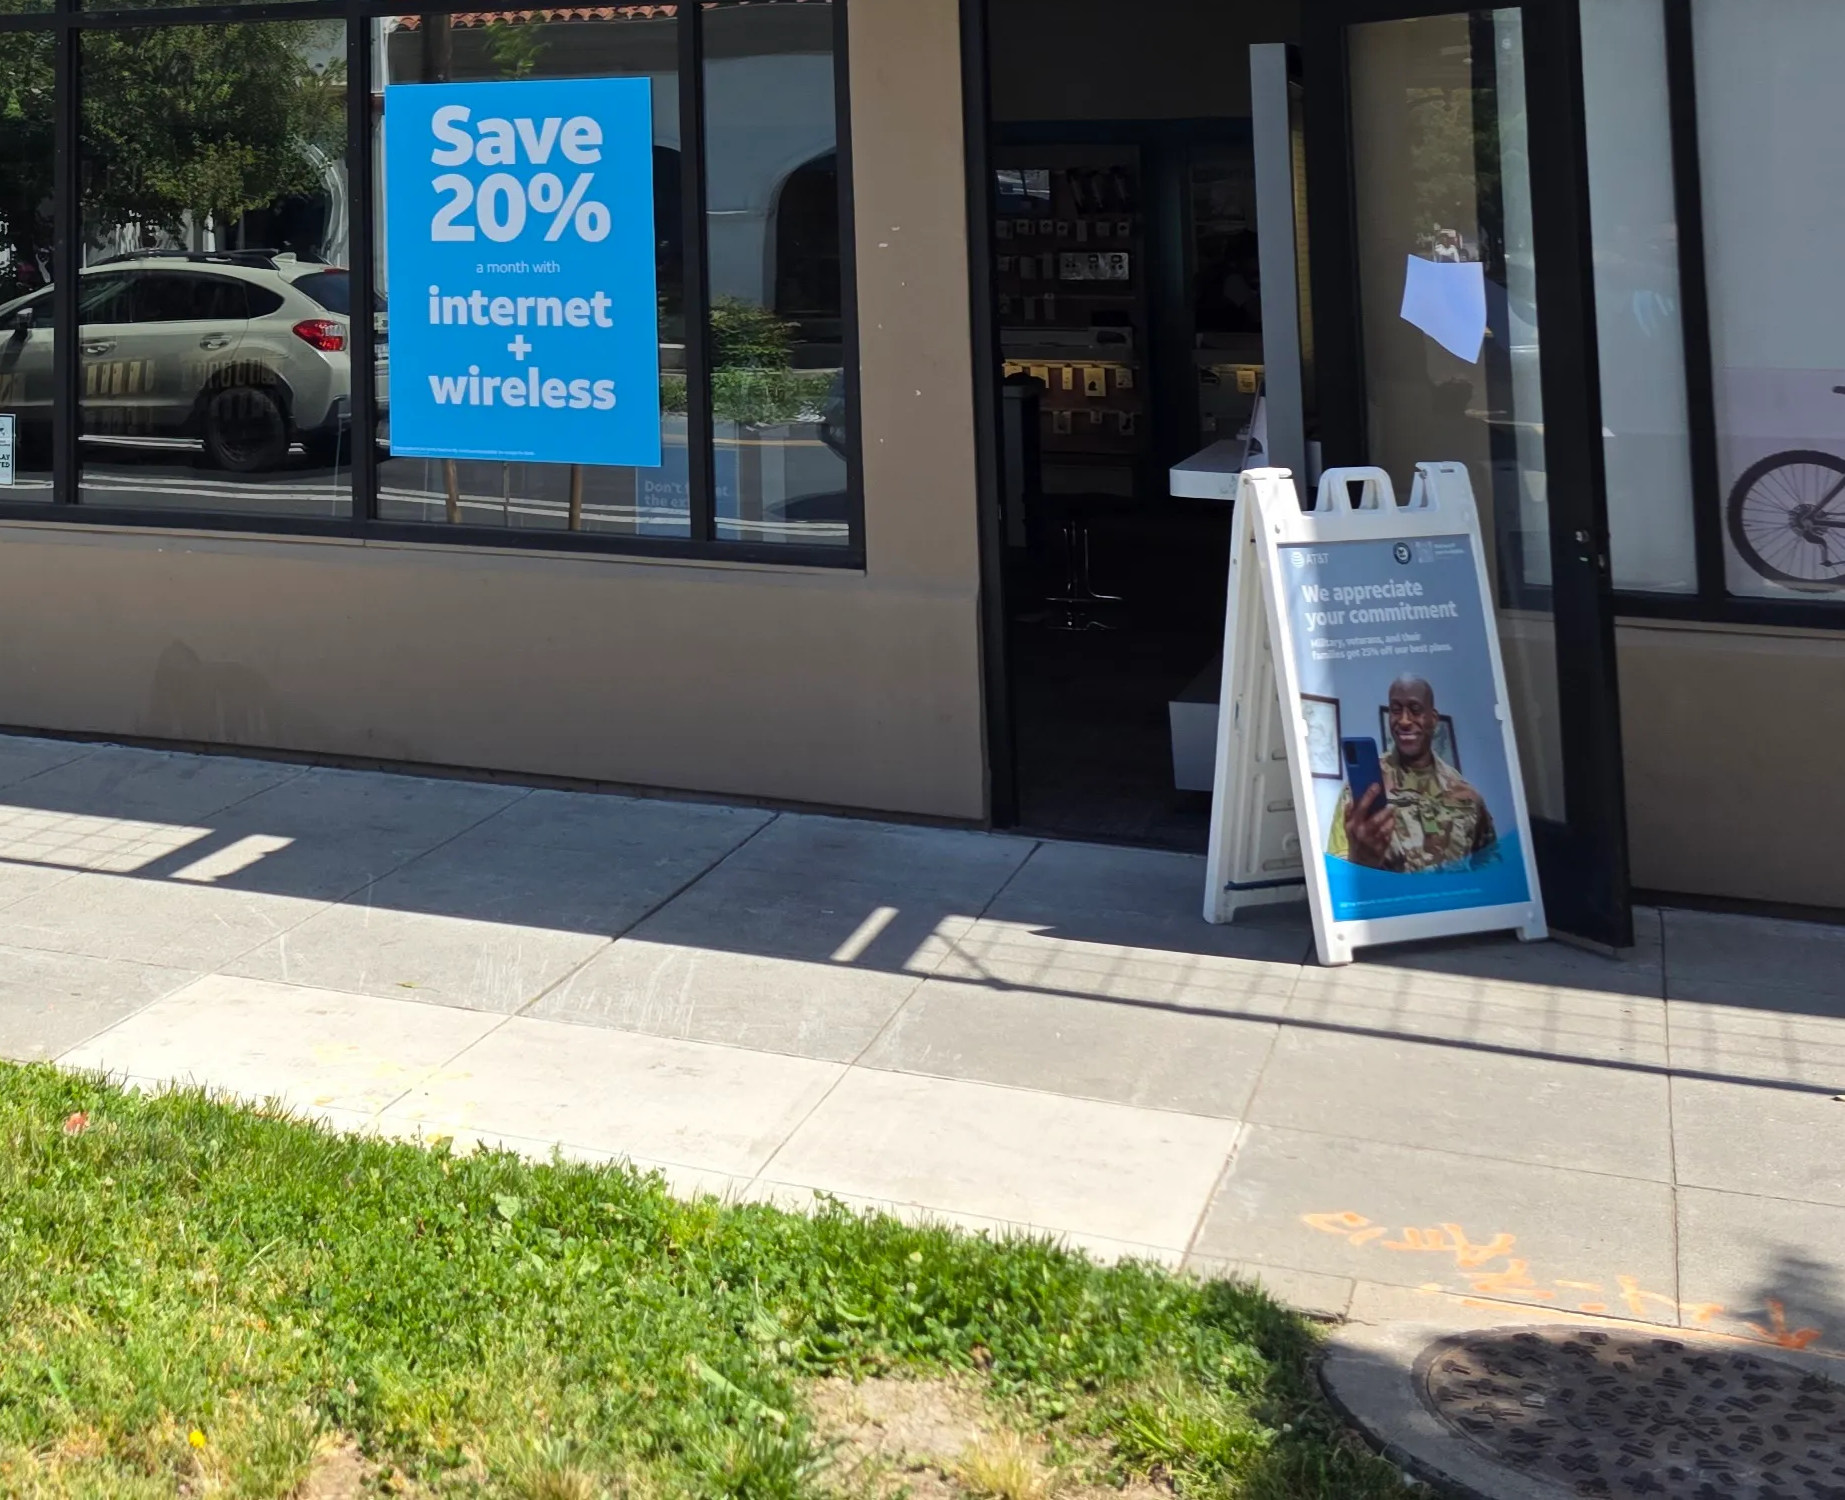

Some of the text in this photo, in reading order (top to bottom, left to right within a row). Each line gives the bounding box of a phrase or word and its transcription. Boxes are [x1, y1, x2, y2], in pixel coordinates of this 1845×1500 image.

[430, 105, 603, 166] Save
[431, 172, 611, 242] 20%
[476, 260, 560, 273] a month with
[429, 285, 613, 328] internet
[507, 334, 532, 361] +
[428, 365, 616, 410] wireless
[644, 480, 682, 493] Don't
[644, 494, 667, 507] the
[1306, 553, 1329, 565] AT&T
[1302, 579, 1424, 605] We appreciate
[1305, 600, 1459, 632] your commitment
[1310, 631, 1422, 649] Military, veterans, and their
[1312, 649, 1345, 660] families
[1346, 649, 1360, 660] get
[1380, 645, 1393, 656] off
[1394, 646, 1409, 654] our
[1409, 644, 1428, 653] best
